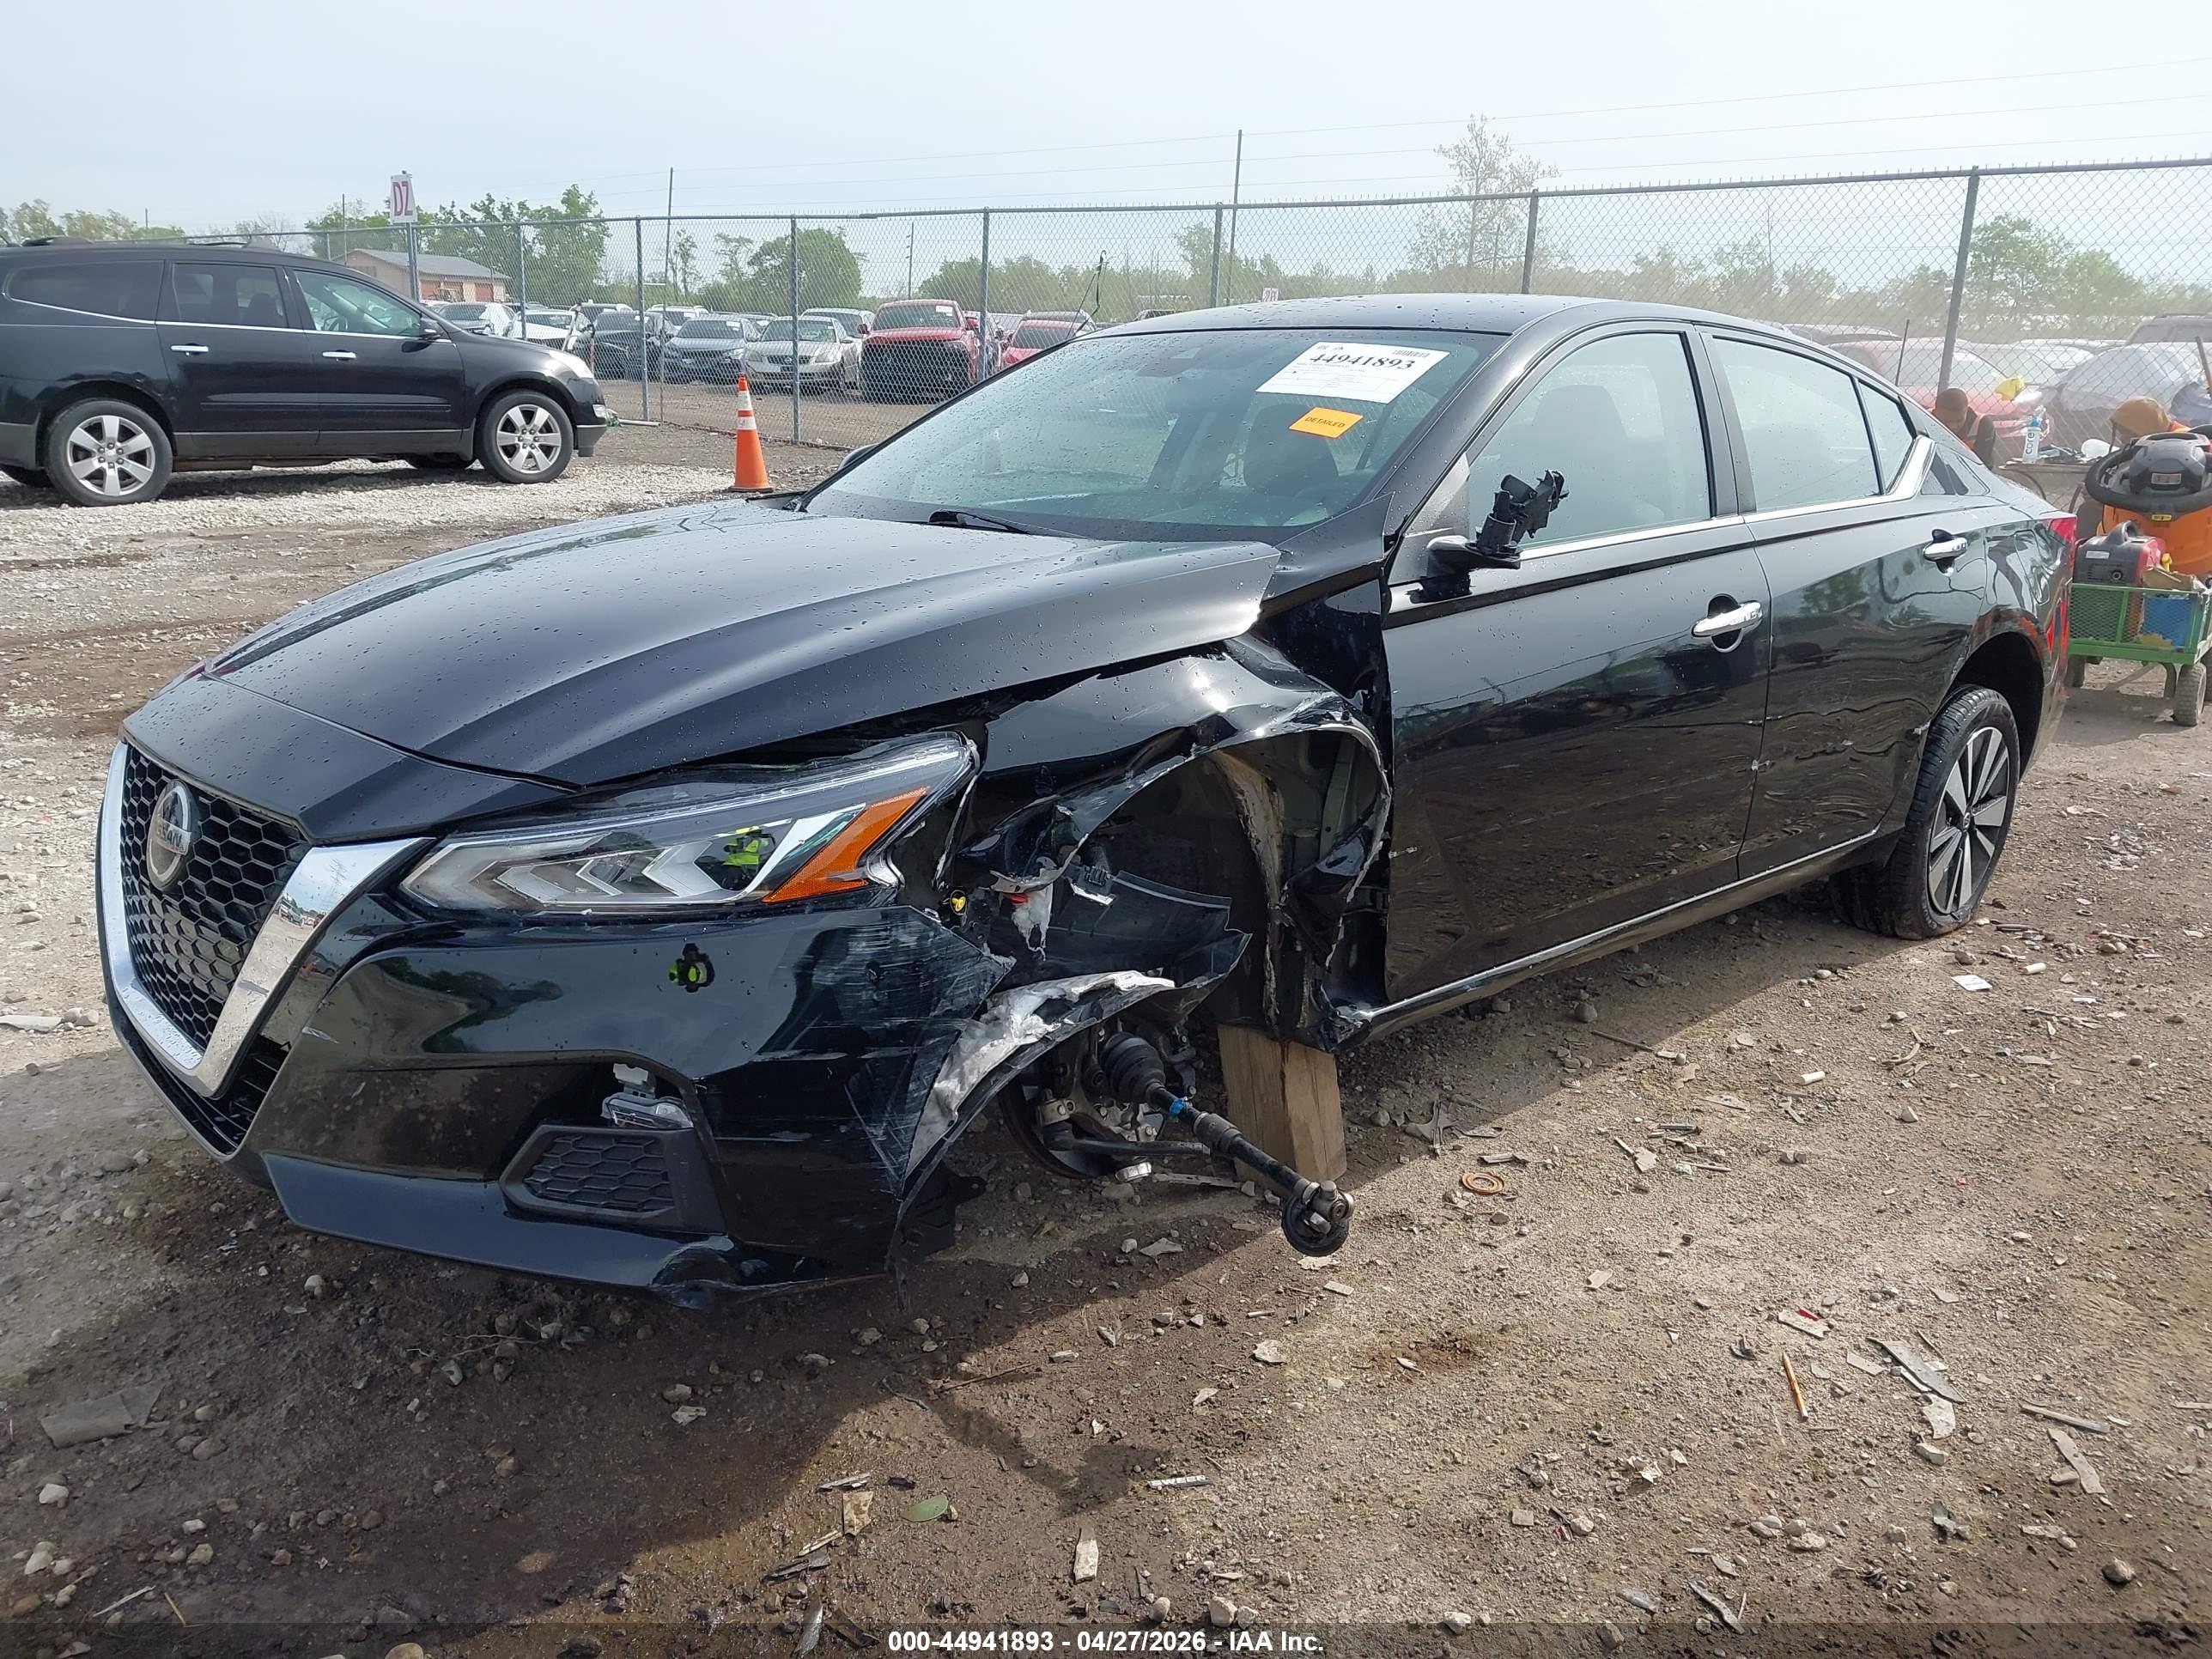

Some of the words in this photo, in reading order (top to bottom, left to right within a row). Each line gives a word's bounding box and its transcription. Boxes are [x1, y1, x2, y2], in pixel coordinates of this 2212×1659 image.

[1310, 353, 1416, 370] 44941893
[1304, 416, 1346, 428] DETAILED
[2025, 432, 2035, 454] core
